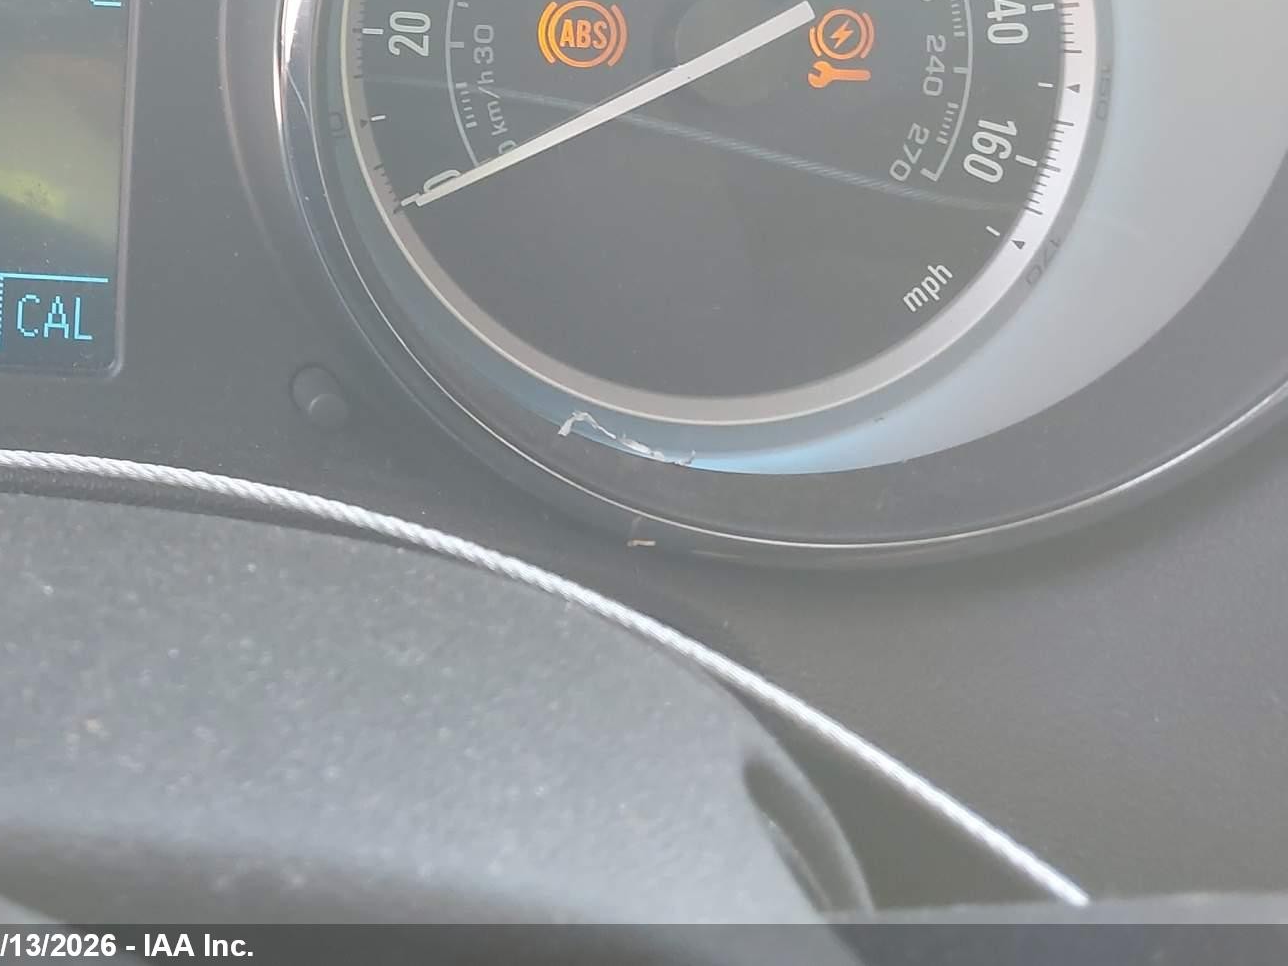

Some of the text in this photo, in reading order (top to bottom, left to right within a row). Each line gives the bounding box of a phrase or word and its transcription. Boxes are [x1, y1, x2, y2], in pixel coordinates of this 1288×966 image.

[388, 10, 432, 57] 20
[473, 24, 495, 65] 30
[559, 18, 609, 50] ABS
[922, 34, 946, 97] 240
[478, 69, 509, 136] km/h
[889, 122, 930, 182] 270
[963, 118, 1018, 184] 160
[902, 261, 953, 312] mph
[16, 293, 93, 340] CAL
